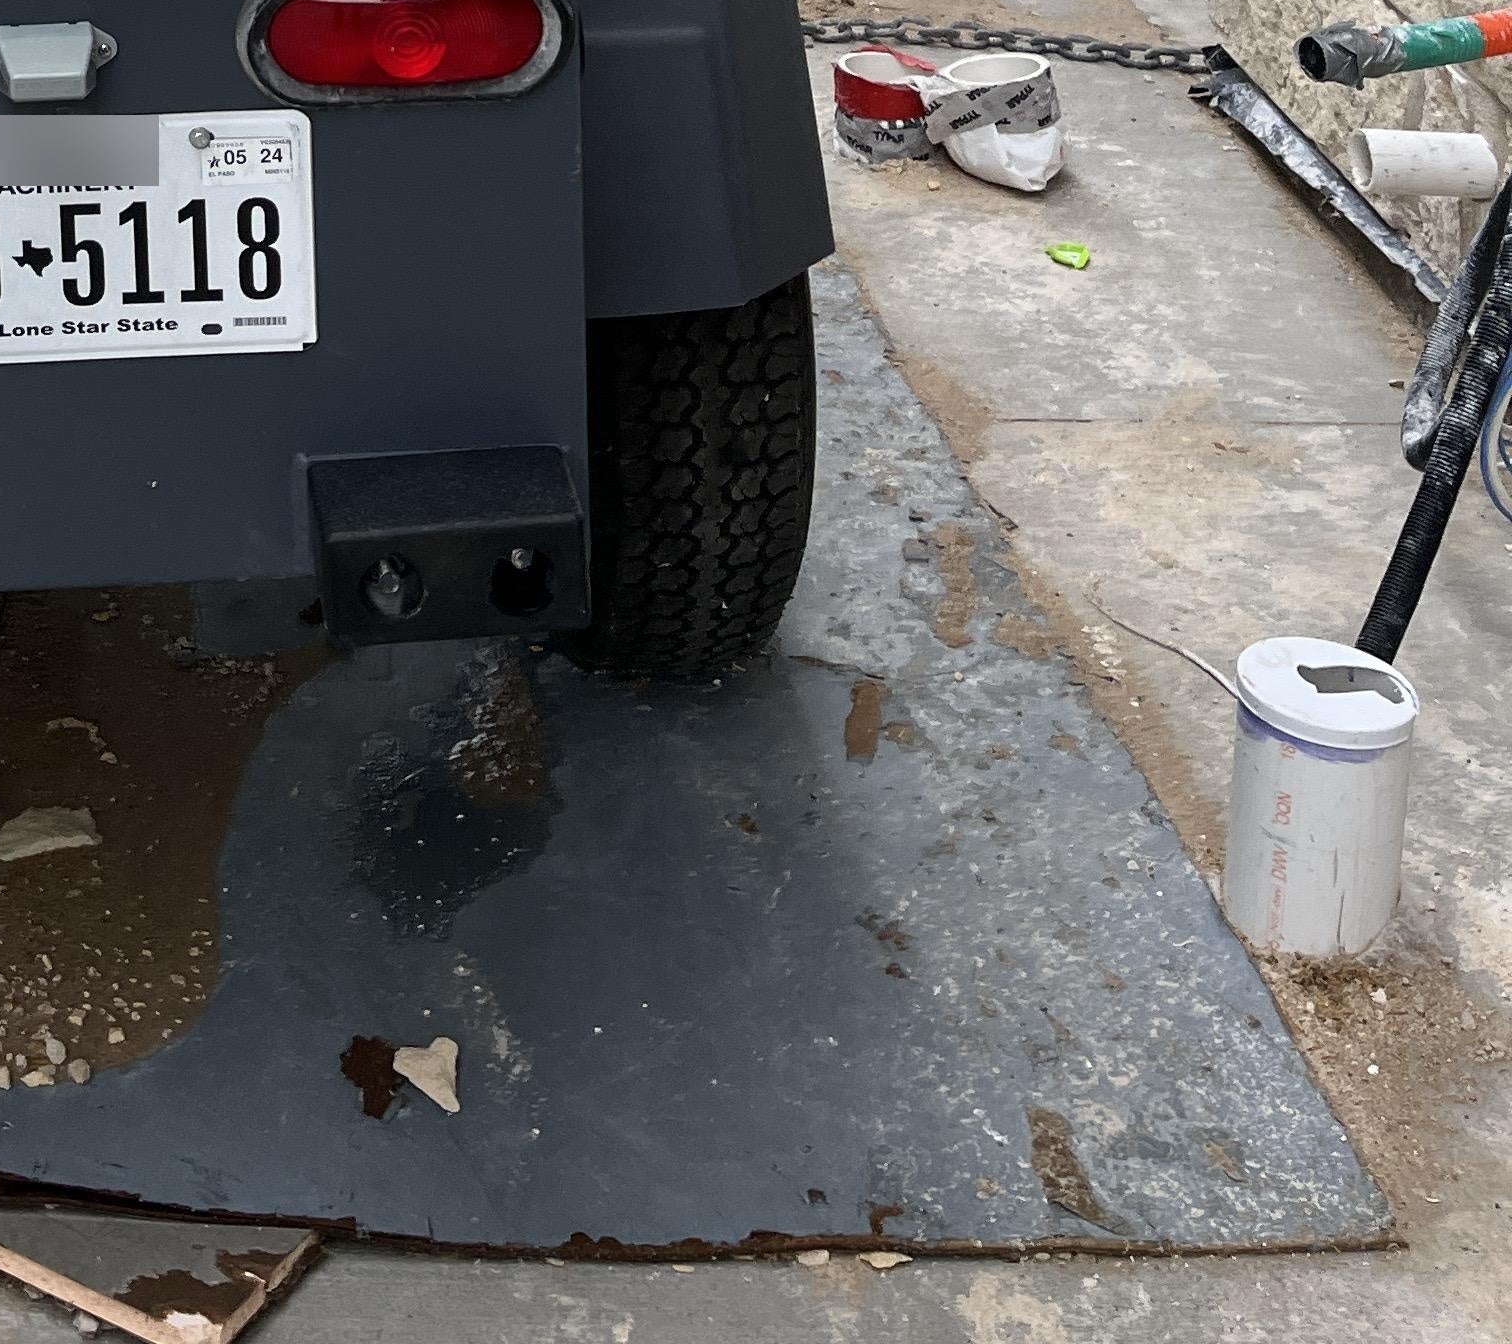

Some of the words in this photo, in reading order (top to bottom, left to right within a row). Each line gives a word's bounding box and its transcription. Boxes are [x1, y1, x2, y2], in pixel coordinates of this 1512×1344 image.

[1006, 84, 1035, 110] TYPAR
[949, 109, 982, 130] TYPAR
[224, 149, 247, 165] 05
[260, 148, 283, 164] 24
[61, 320, 110, 336] Star
[117, 317, 178, 333] State
